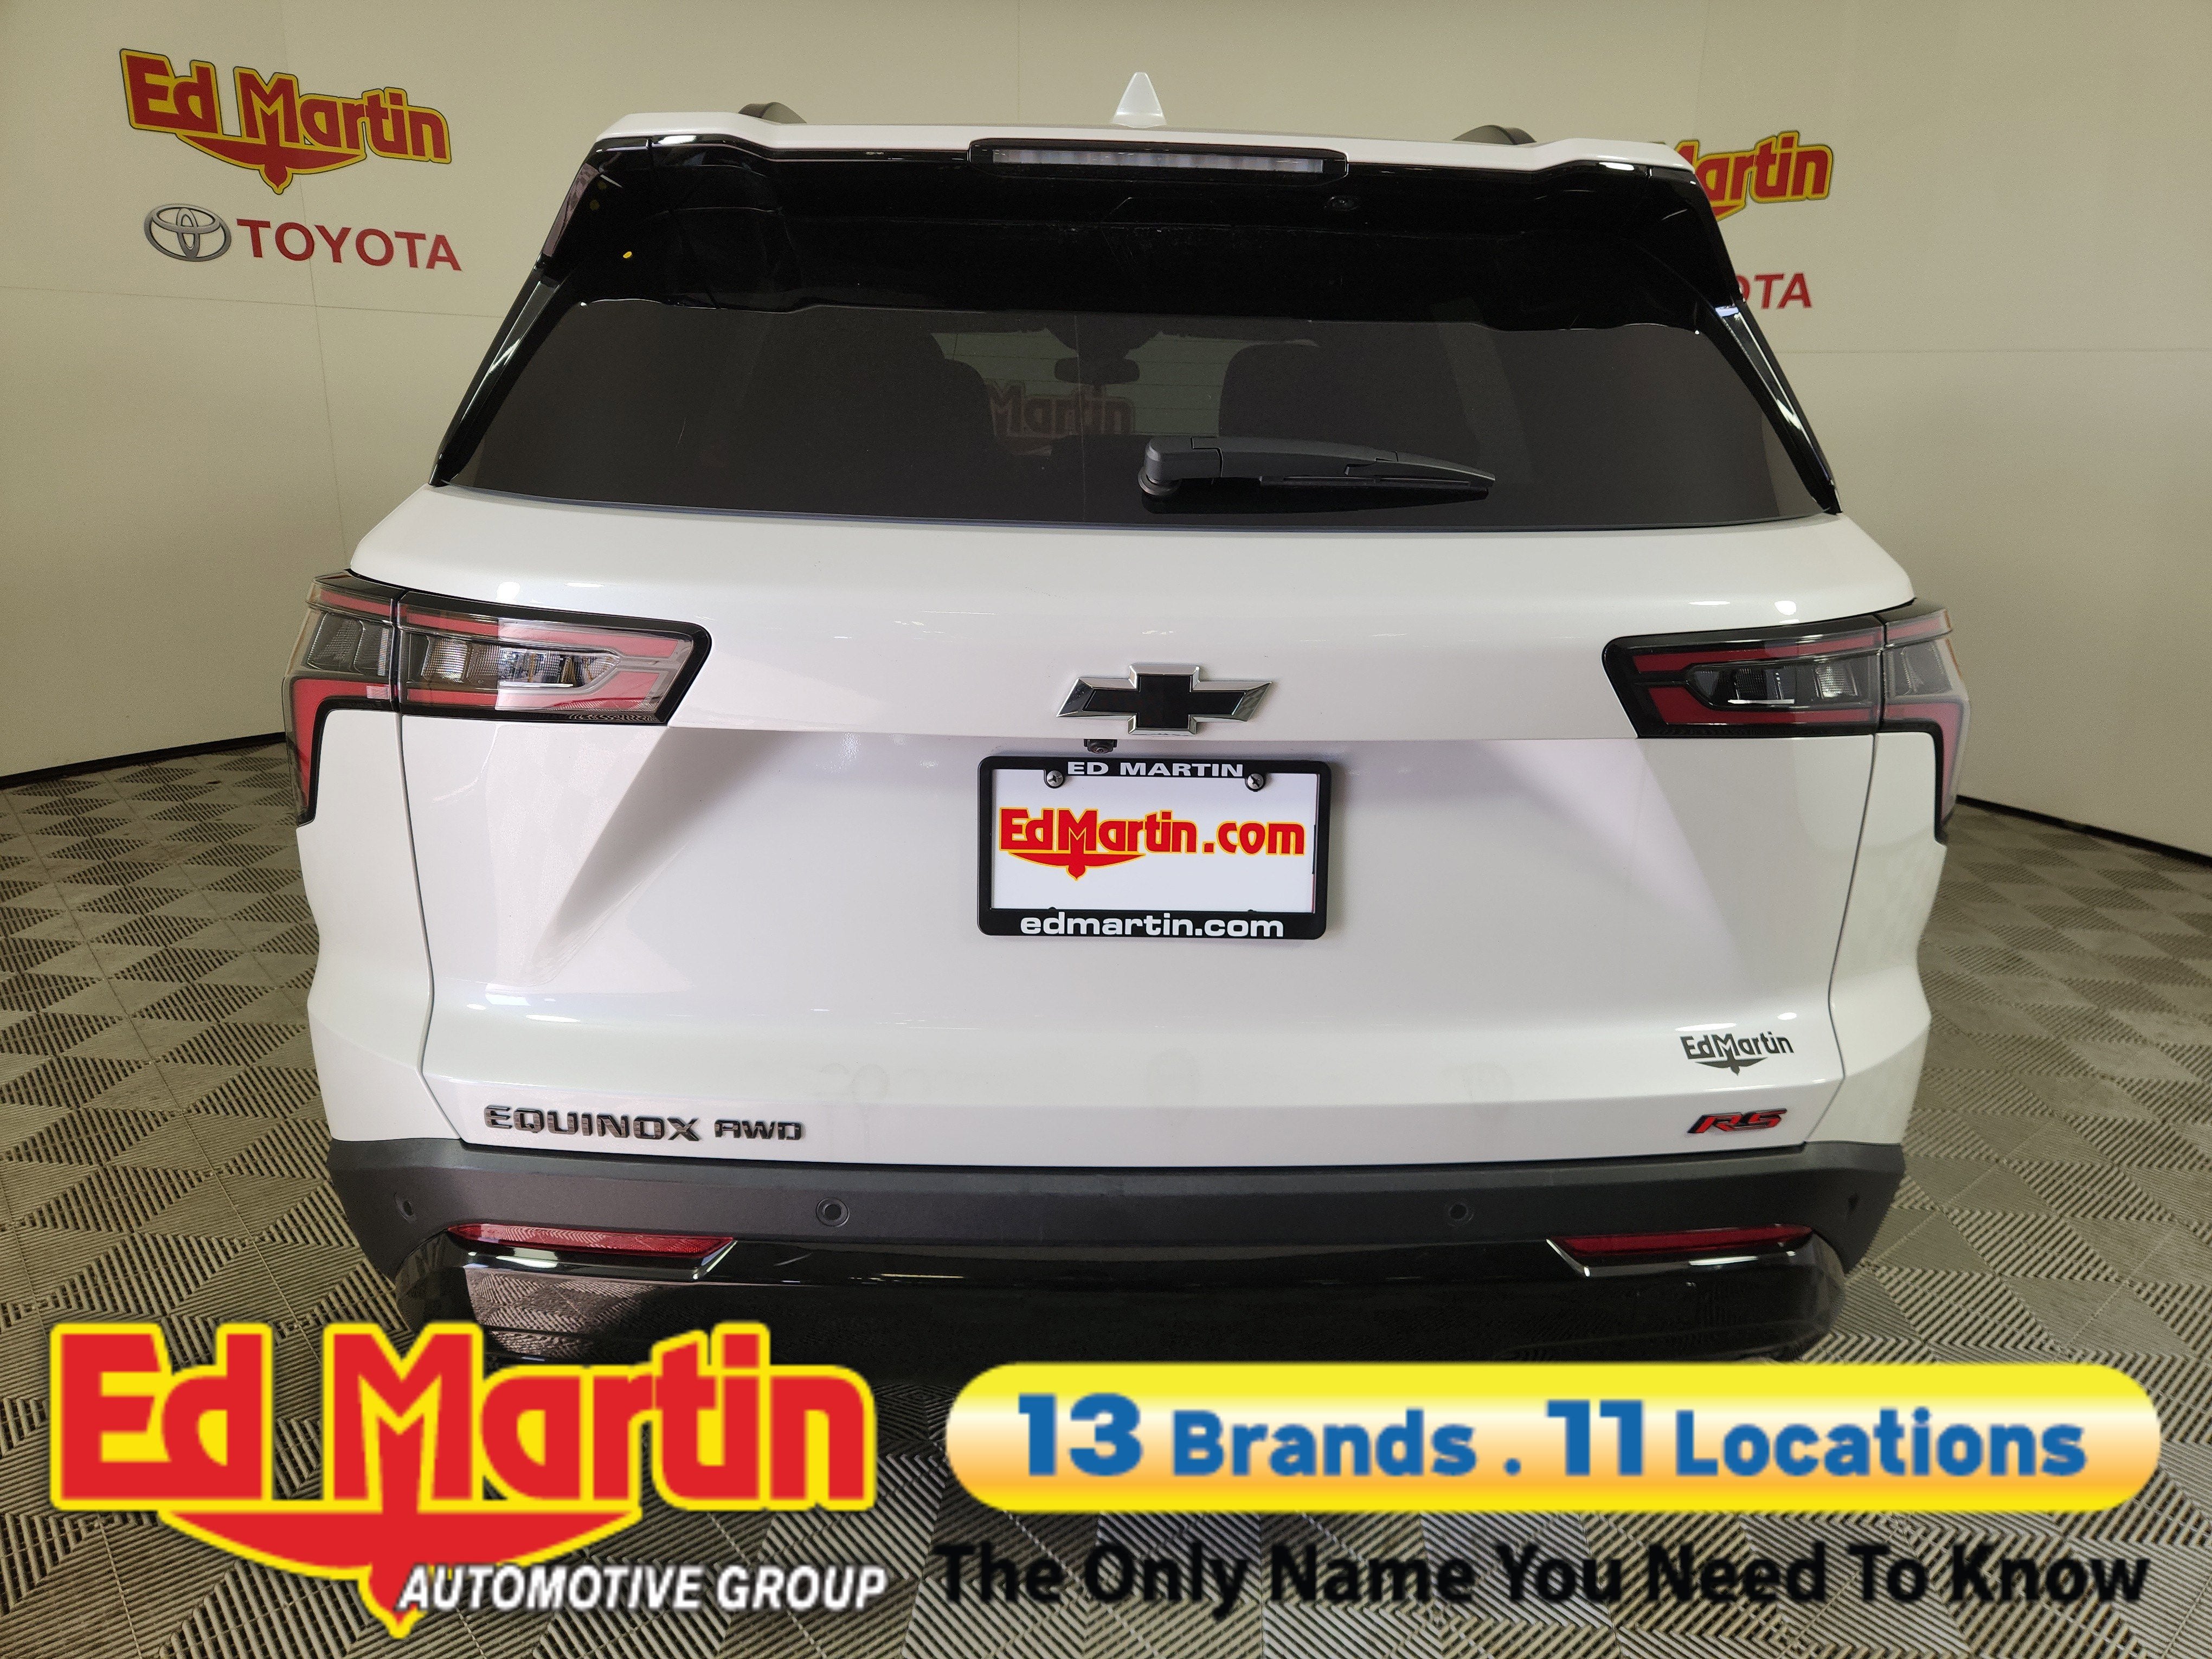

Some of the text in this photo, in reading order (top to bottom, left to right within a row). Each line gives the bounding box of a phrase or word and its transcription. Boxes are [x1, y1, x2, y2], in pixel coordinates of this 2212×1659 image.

[120, 49, 452, 164] Ed Martin
[1675, 130, 1834, 204] artin
[236, 217, 462, 271] TOYOTA
[1068, 762, 1244, 777] ED MARTIN
[1020, 912, 1284, 937] edmartin.com
[483, 1104, 805, 1142] EQUINOX AWD
[1687, 1108, 1787, 1134] RS
